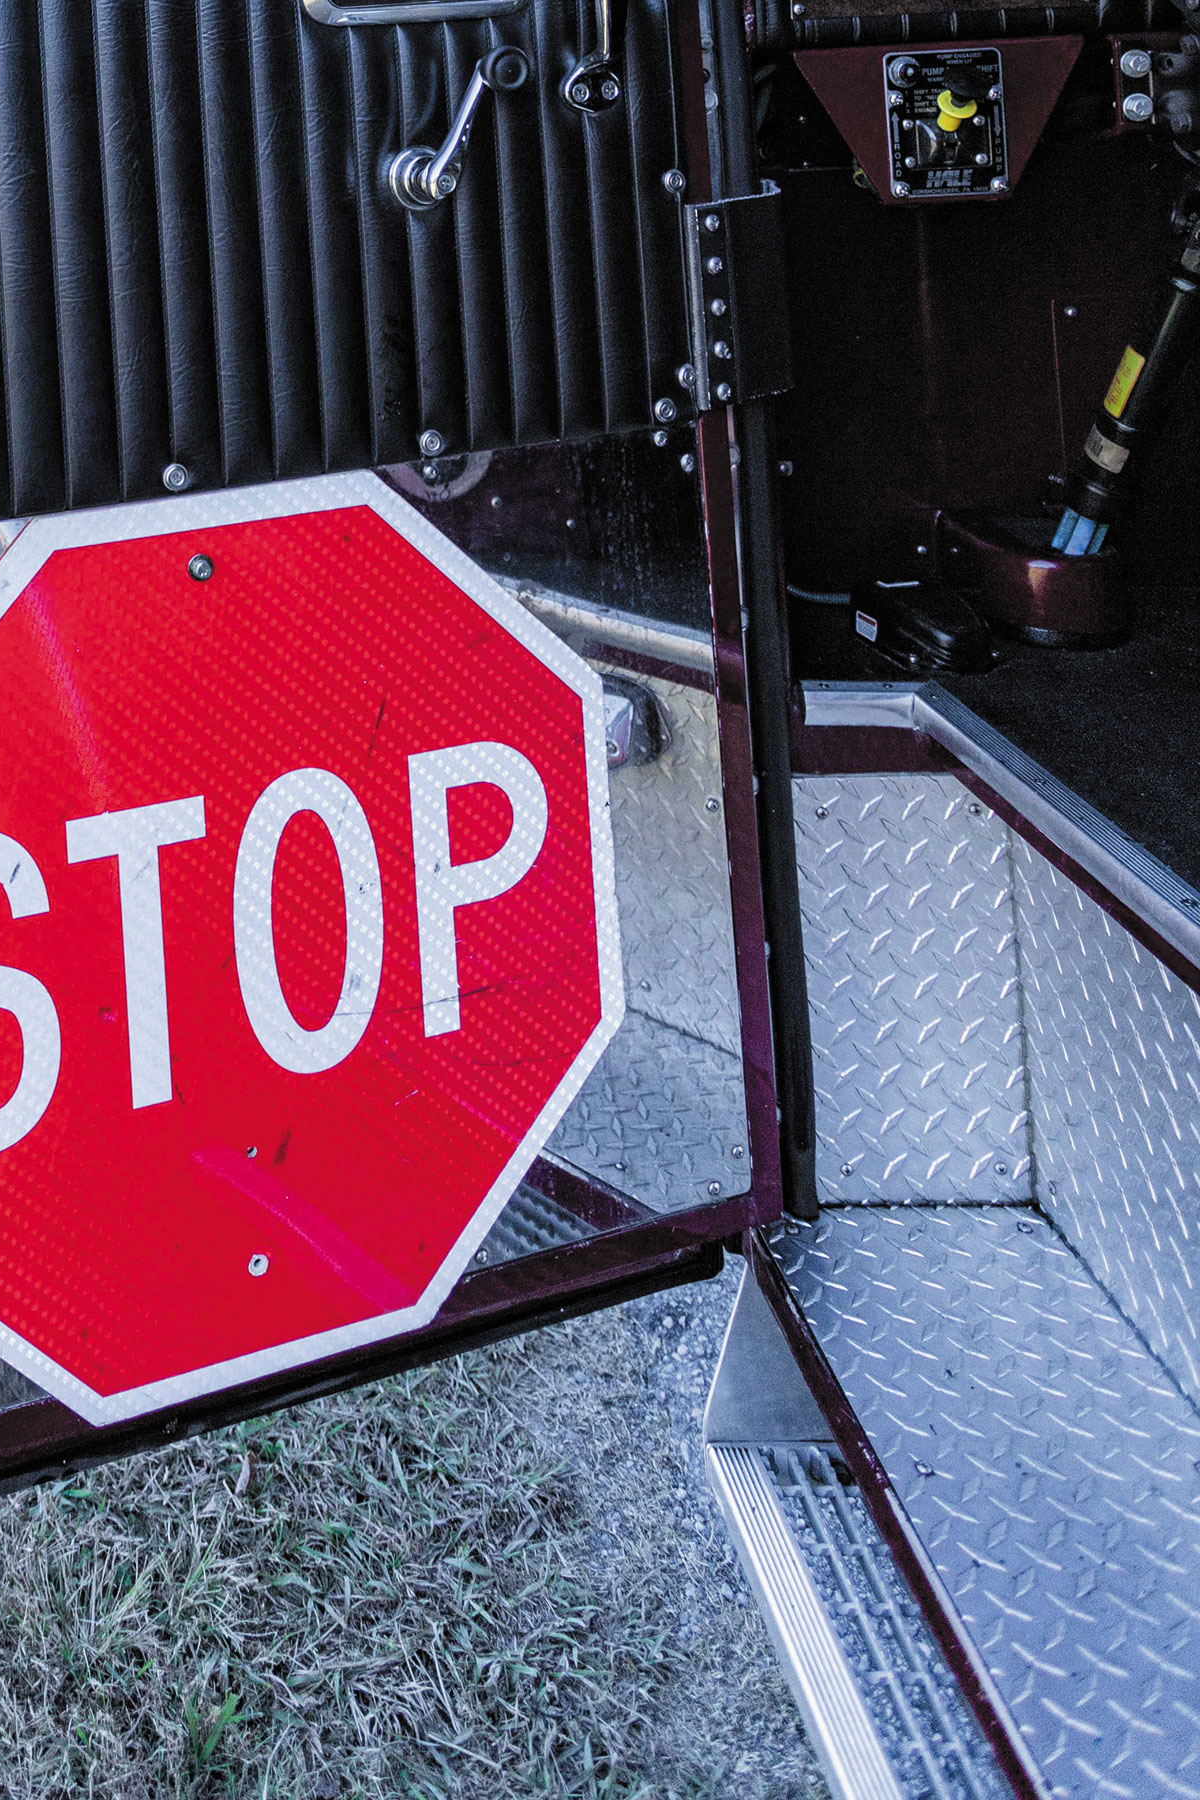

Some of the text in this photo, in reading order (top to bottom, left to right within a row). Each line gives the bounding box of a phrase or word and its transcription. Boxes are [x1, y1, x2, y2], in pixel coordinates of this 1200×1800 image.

[921, 67, 945, 76] PUMP
[893, 143, 903, 177] ROAD
[994, 137, 1004, 172] PUMP
[926, 168, 974, 188] HALE
